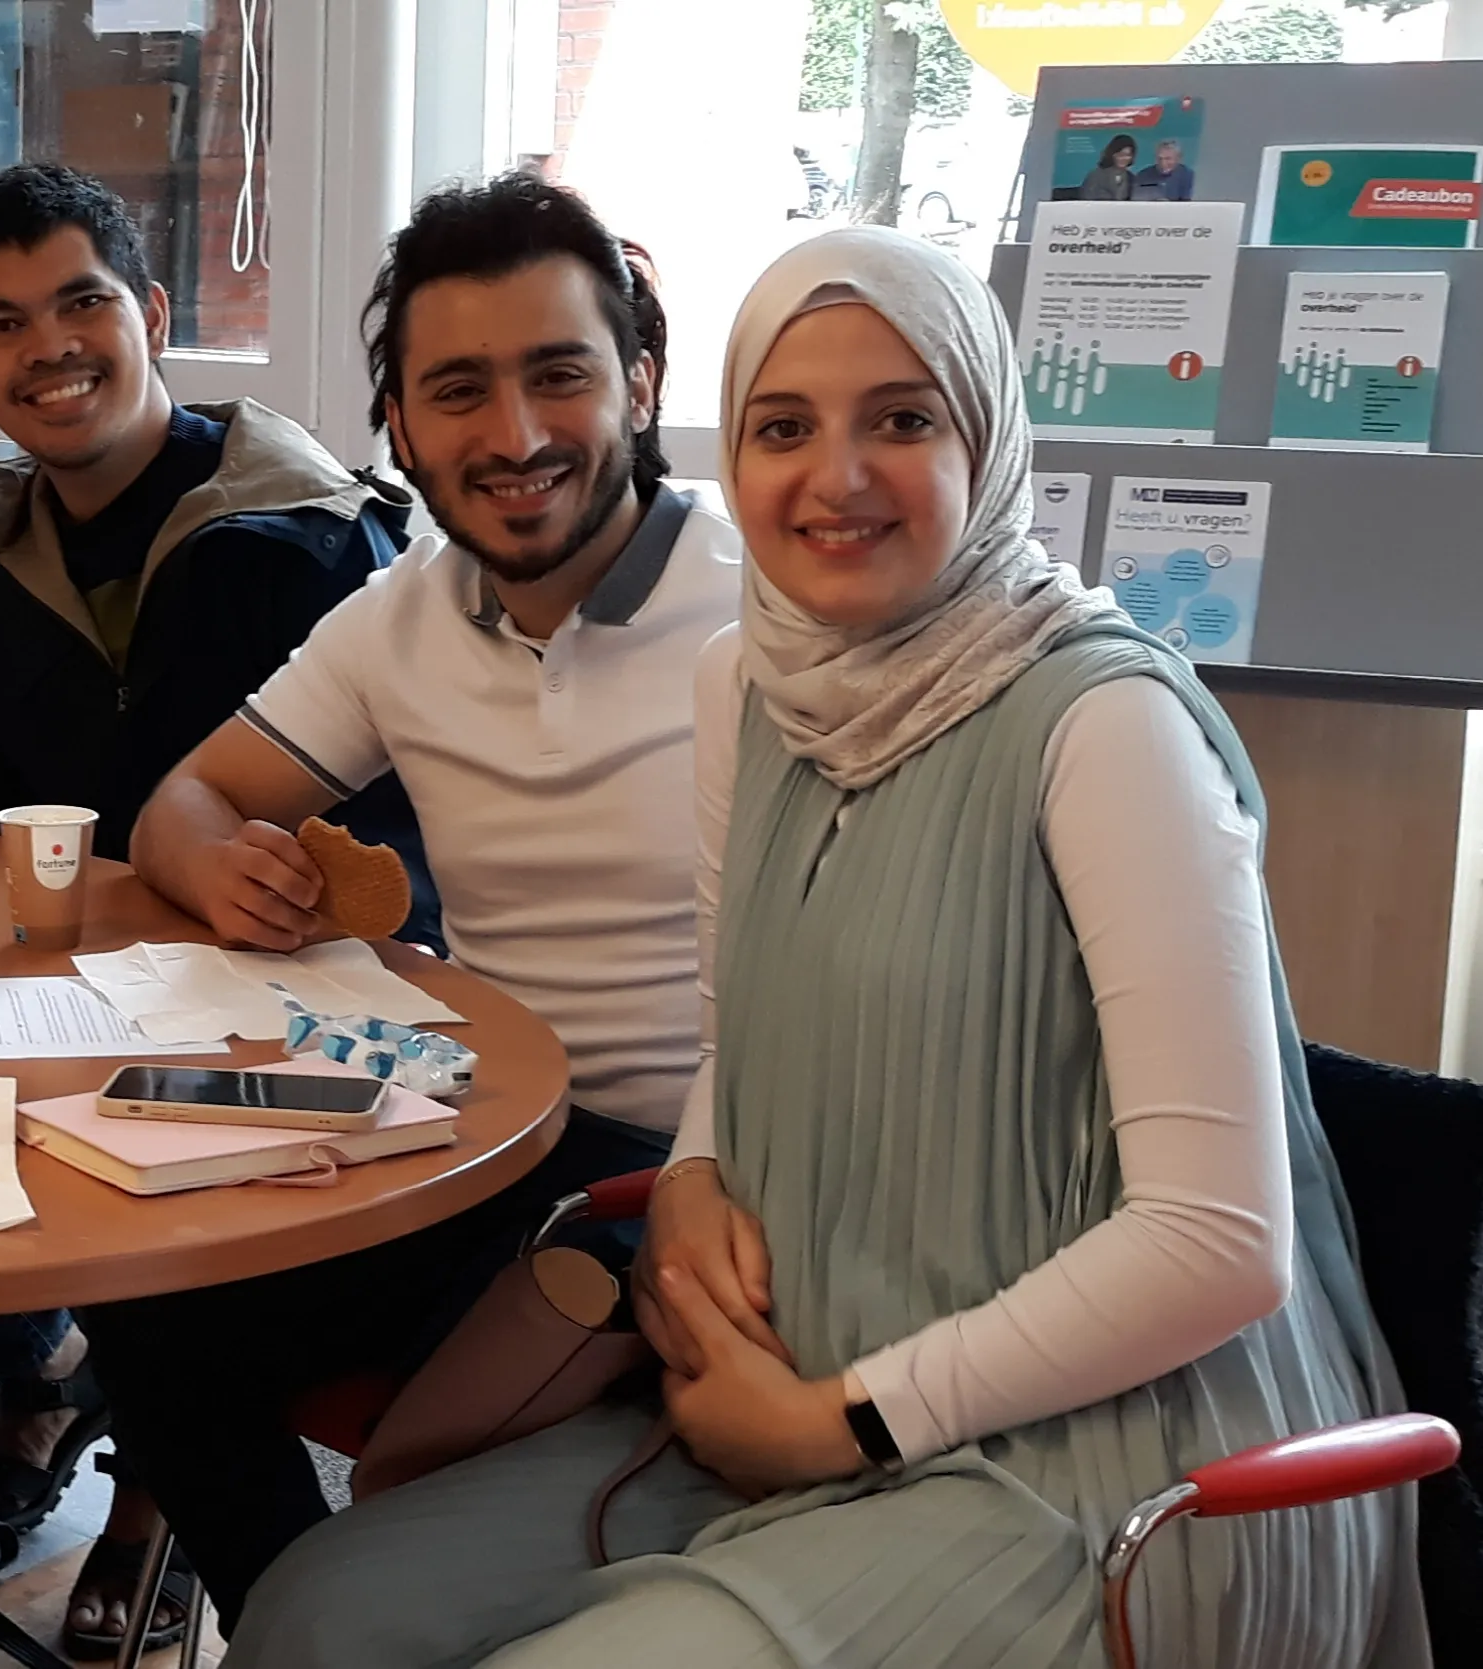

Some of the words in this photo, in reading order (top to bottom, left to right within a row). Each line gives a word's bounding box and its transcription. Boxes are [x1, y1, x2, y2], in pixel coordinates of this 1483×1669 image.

[1372, 186, 1474, 204] Cadeaubon
[1101, 226, 1152, 240] vragen
[1155, 226, 1189, 238] over
[1192, 225, 1213, 239] de
[1048, 241, 1131, 255] overheid?
[1183, 513, 1253, 530] vragen?
